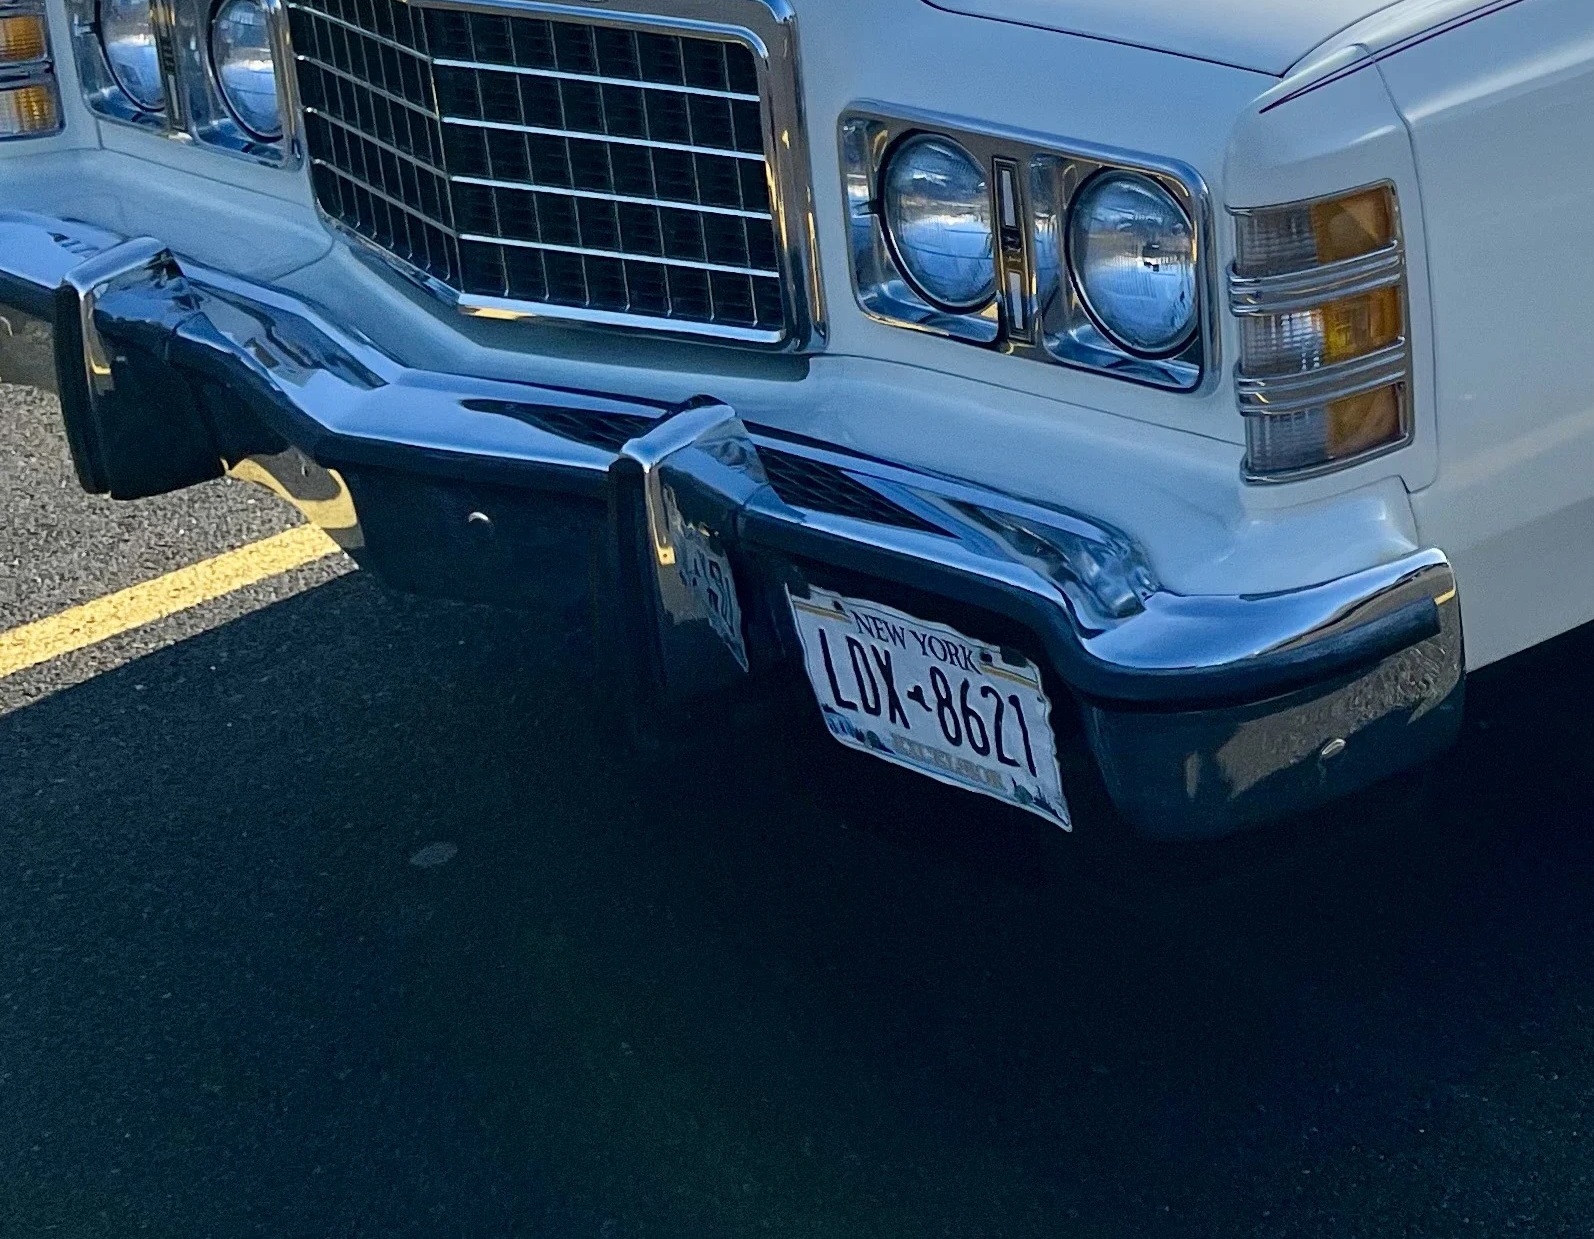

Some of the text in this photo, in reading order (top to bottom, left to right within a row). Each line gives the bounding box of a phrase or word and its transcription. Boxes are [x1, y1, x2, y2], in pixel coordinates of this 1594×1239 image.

[850, 610, 982, 675] NEW YORK
[929, 666, 1037, 778] 8621
